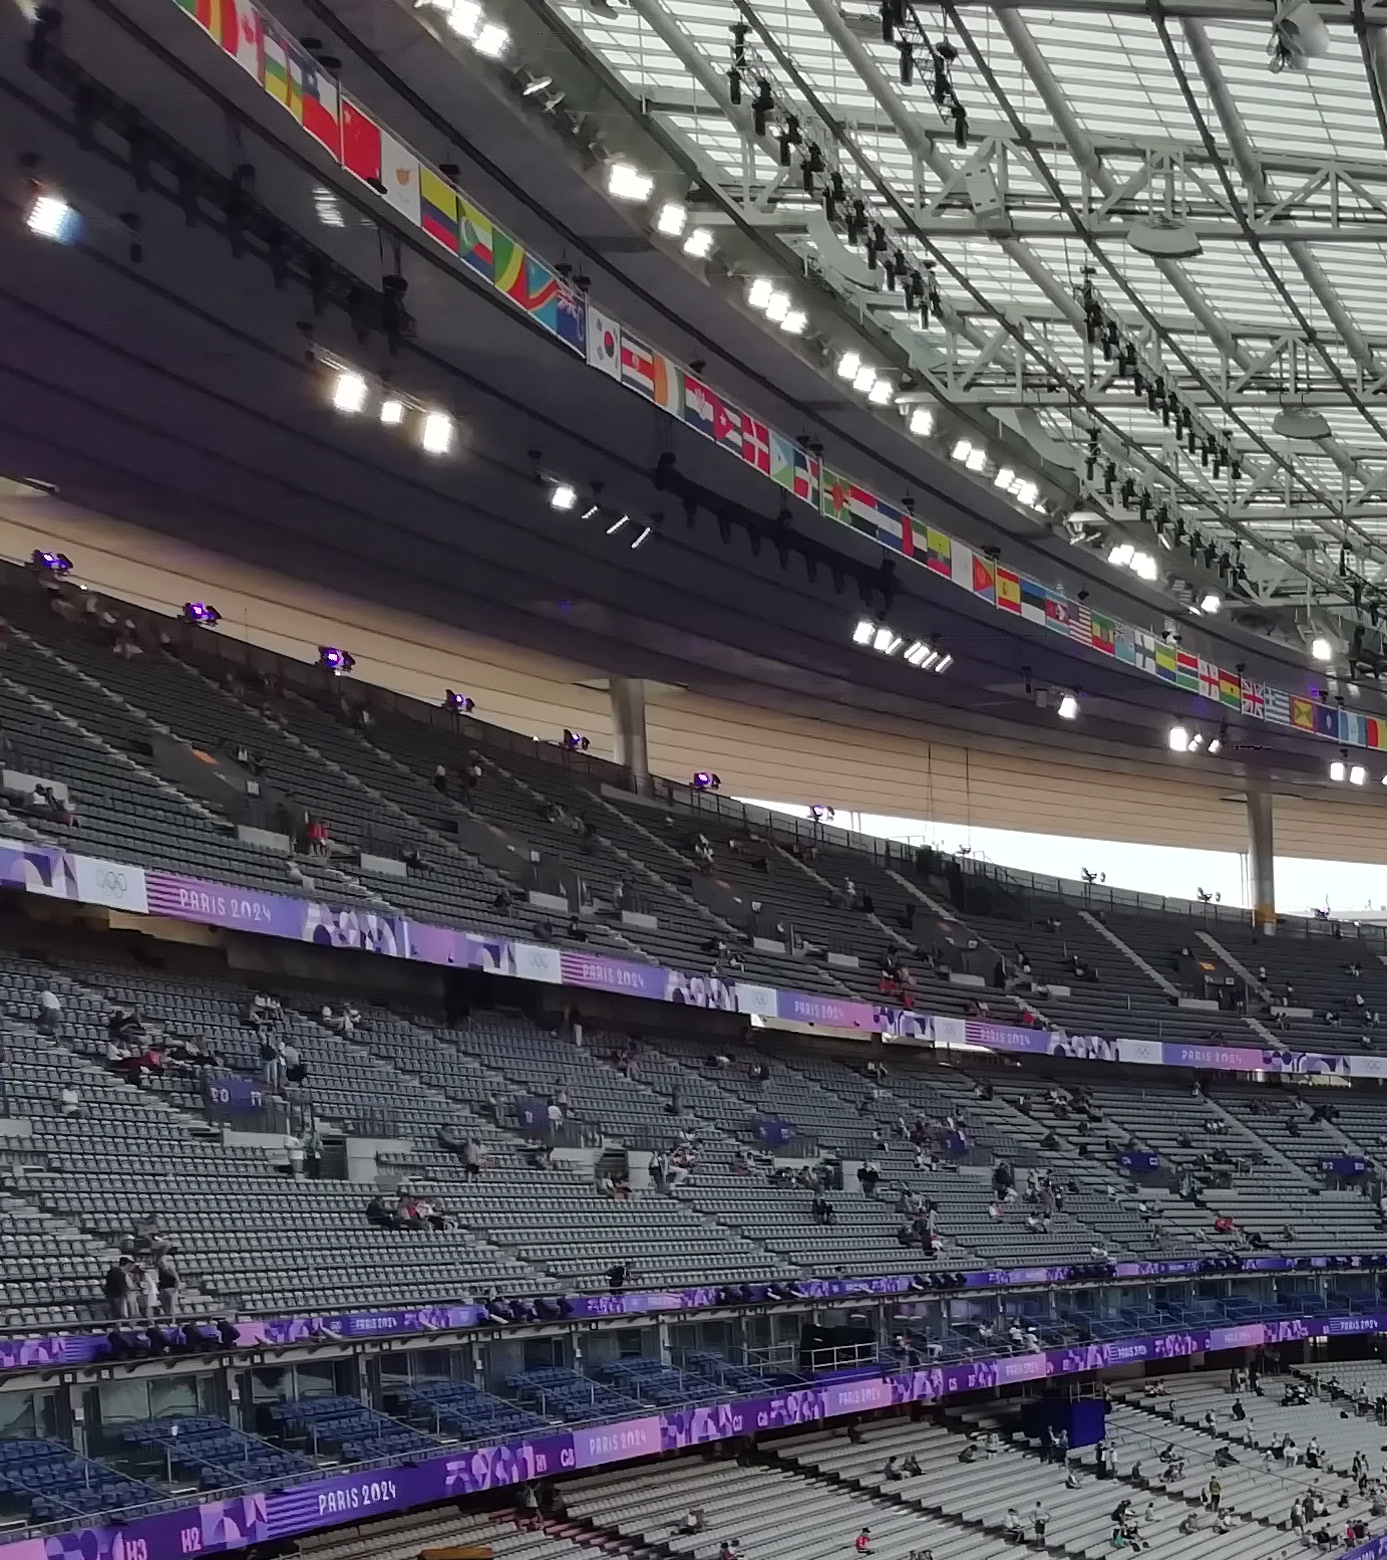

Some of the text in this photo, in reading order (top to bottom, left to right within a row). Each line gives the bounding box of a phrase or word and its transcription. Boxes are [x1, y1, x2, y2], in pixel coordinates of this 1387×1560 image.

[180, 889, 271, 921] PARIS 2024
[583, 963, 644, 988] PARIS 2024
[795, 1000, 843, 1018] PARIS 2024
[981, 1029, 1031, 1046] PARIS 2024
[1182, 1050, 1242, 1064] PARIS 2024
[1340, 1321, 1359, 1331] PARIS
[1360, 1319, 1378, 1329] 2024
[590, 1429, 646, 1455] PARIS 2024
[318, 1481, 397, 1516] PARIS 2024
[181, 1527, 202, 1553] H2
